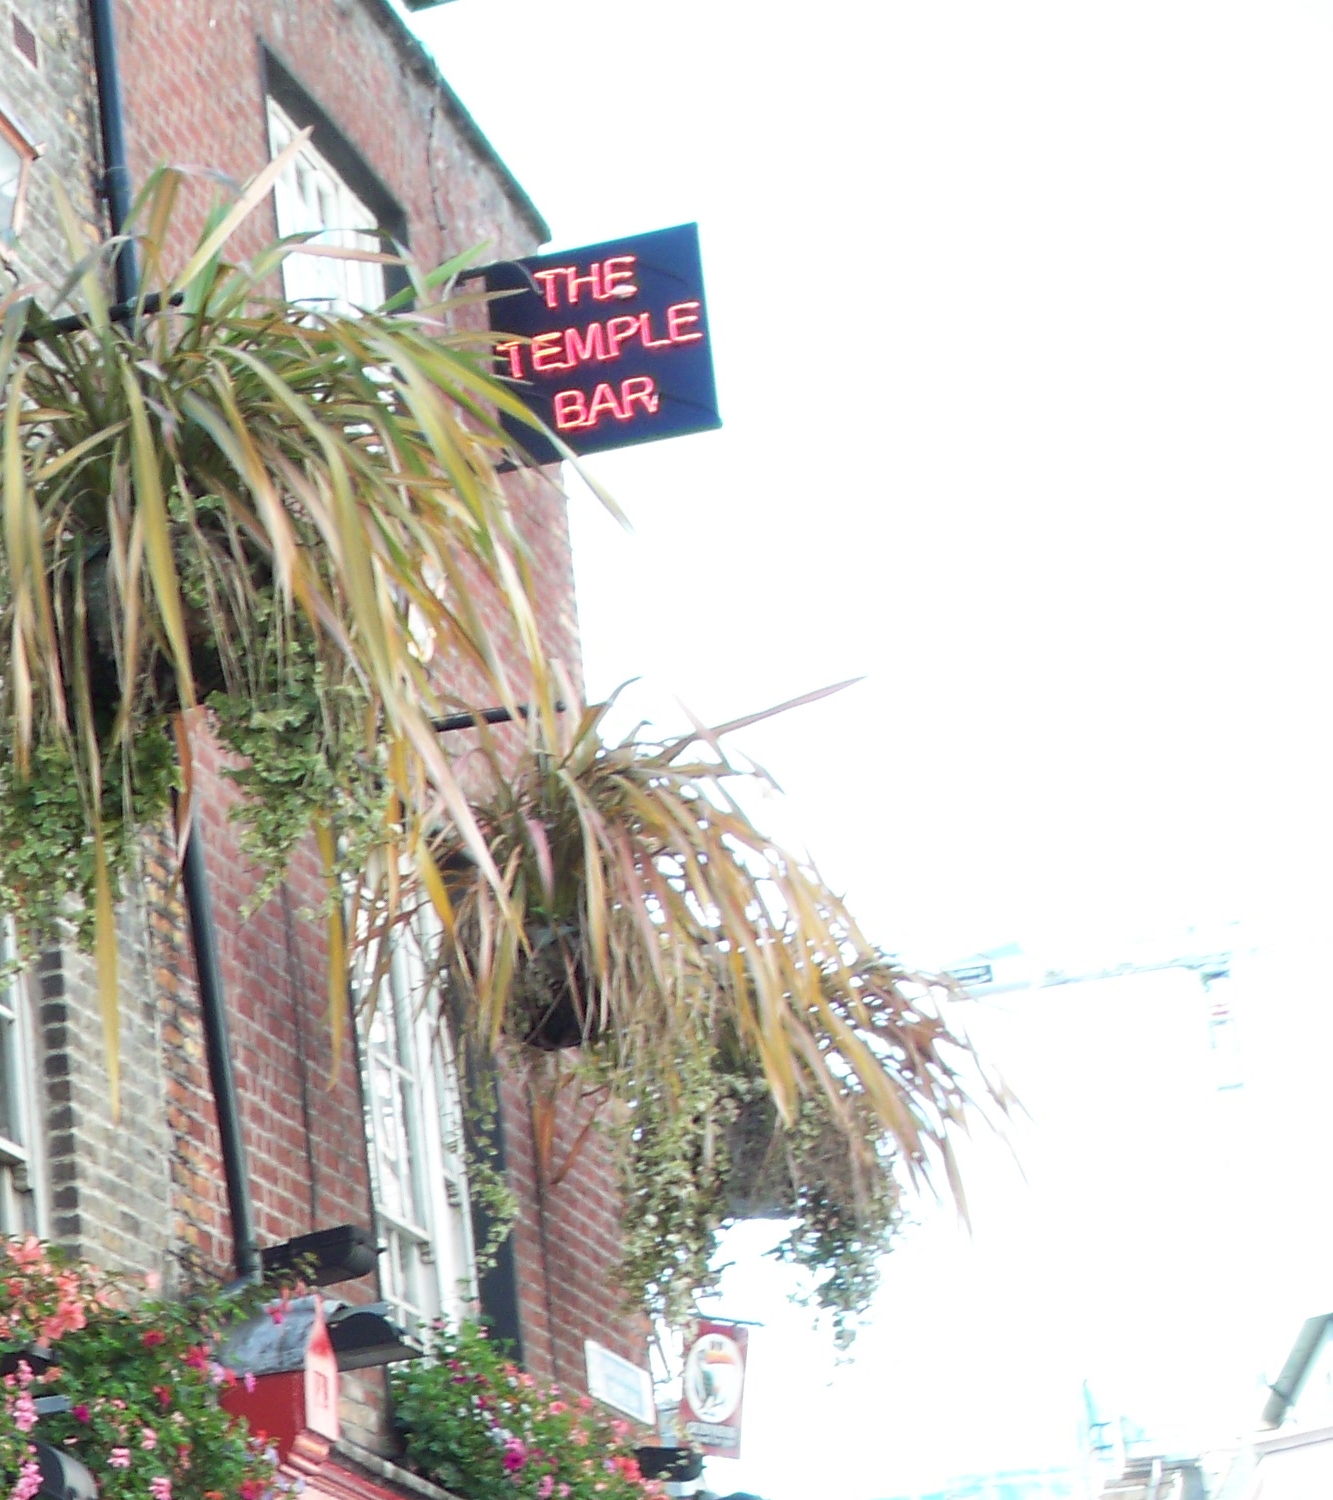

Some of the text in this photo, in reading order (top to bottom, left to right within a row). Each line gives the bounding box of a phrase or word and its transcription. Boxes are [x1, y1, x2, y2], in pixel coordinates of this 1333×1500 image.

[534, 255, 638, 309] THE
[496, 300, 704, 379] TEMPLE
[553, 376, 660, 429] BAR
